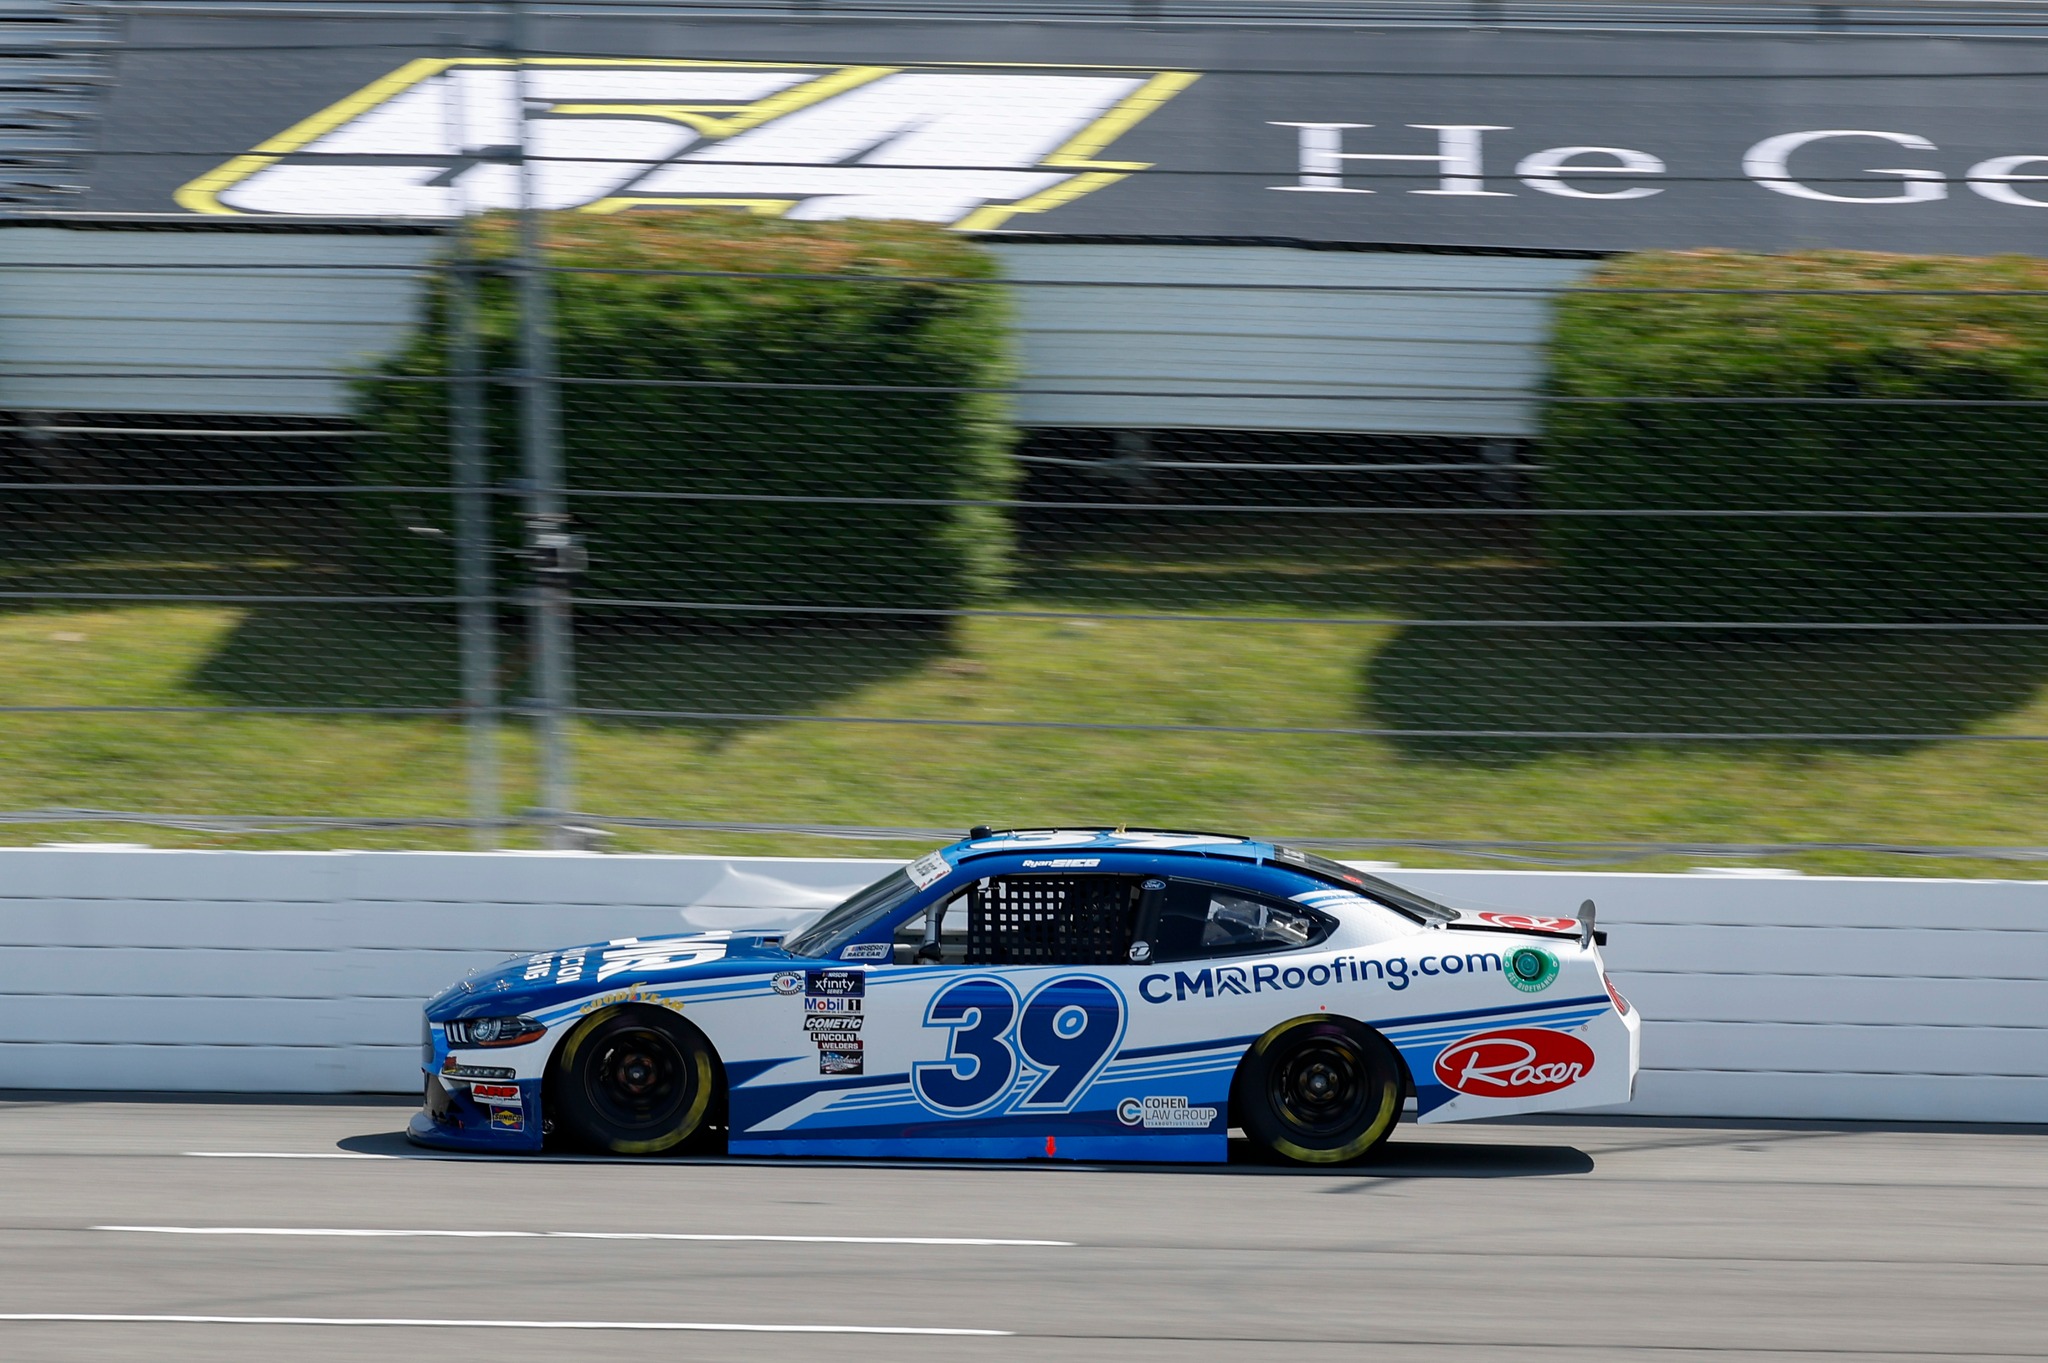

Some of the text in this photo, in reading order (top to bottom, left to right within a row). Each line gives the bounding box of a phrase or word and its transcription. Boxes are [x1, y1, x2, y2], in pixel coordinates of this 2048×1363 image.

[1265, 119, 1667, 200] He
[815, 977, 855, 992] xfinity
[580, 987, 685, 1014] GOODYEAR
[804, 997, 844, 1010] Mobil
[806, 1017, 862, 1029] COMETIC
[812, 1033, 855, 1042] LINCOLN
[821, 1042, 859, 1050] WELDERS
[909, 972, 1129, 1118] 39
[473, 1084, 518, 1097] ARP
[1145, 1098, 1187, 1109] COHEN
[493, 1112, 523, 1123] SUNOCO
[1145, 1109, 1216, 1121] LAW GROUP
